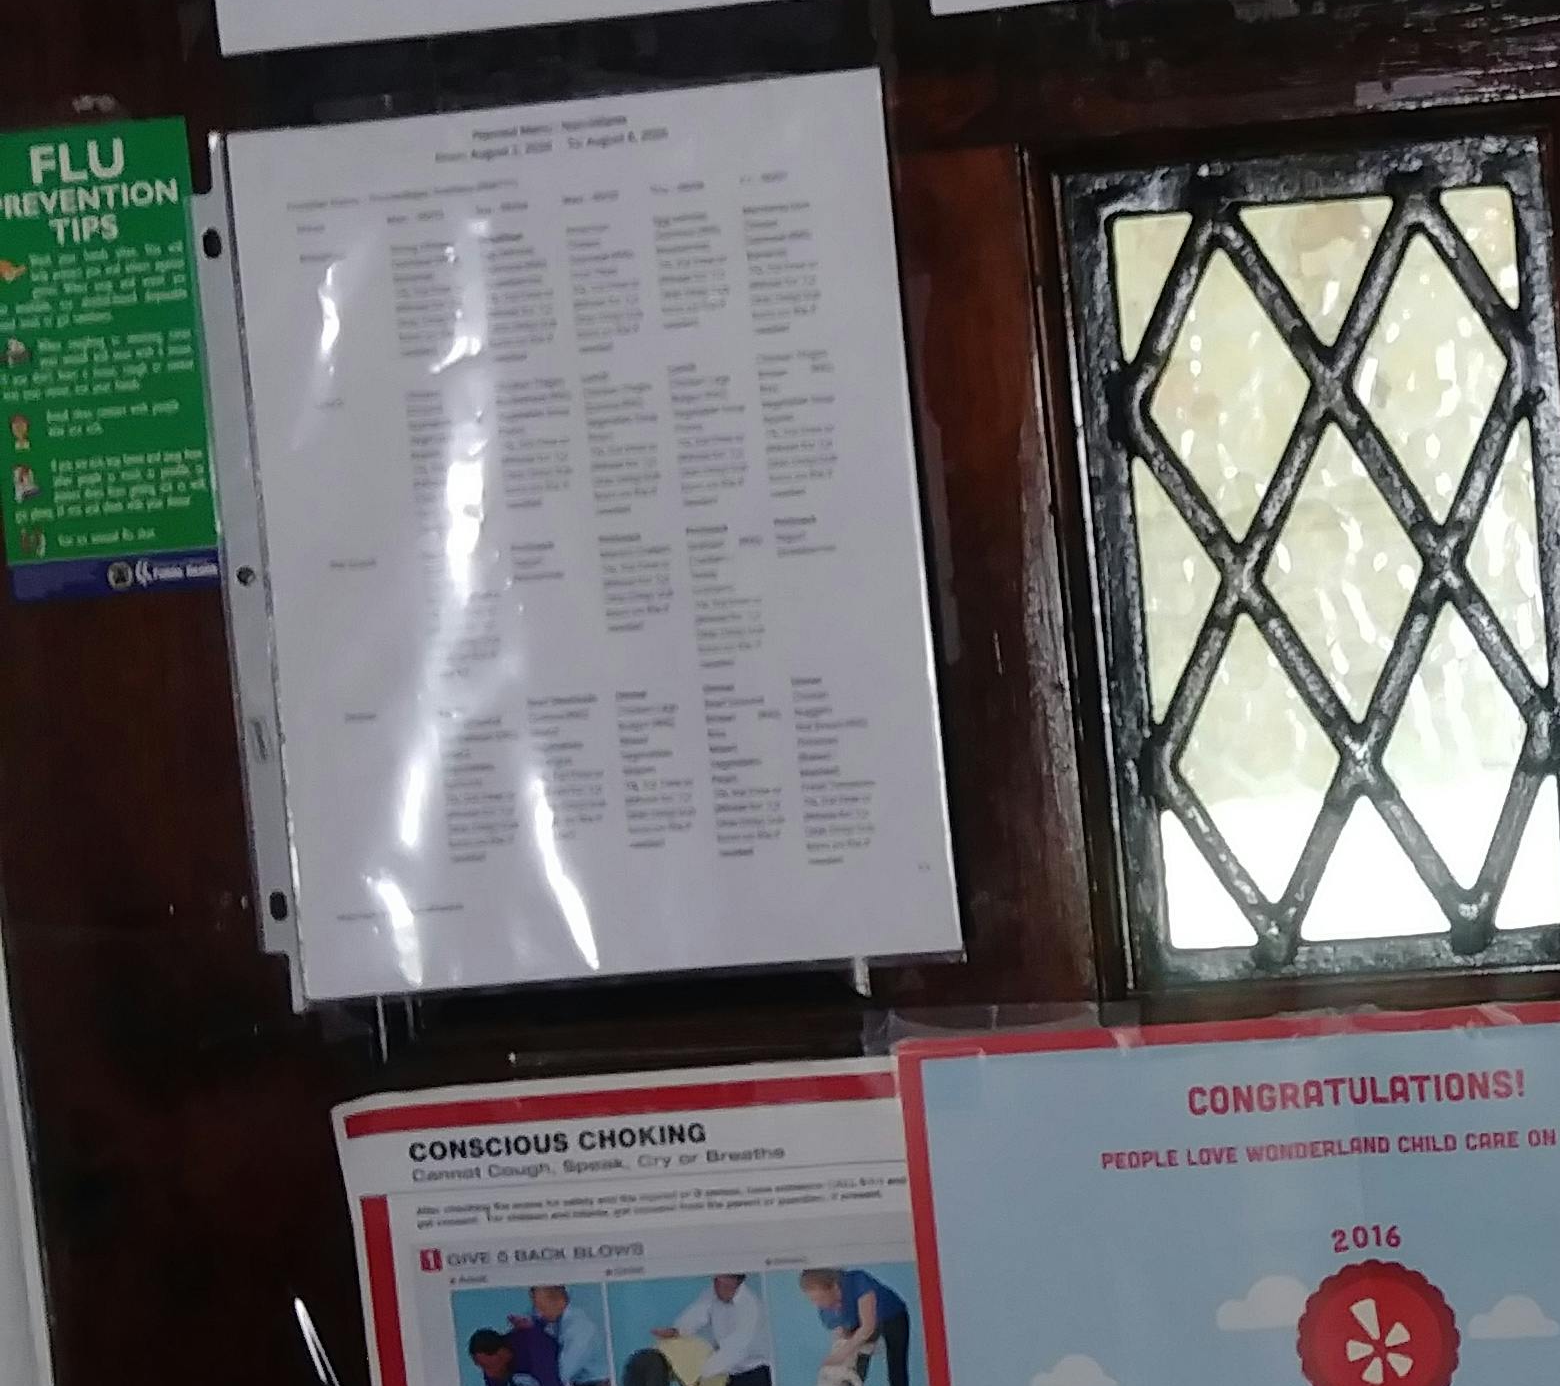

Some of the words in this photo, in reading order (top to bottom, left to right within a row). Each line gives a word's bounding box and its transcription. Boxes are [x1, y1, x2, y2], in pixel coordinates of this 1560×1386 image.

[30, 137, 126, 187] FLU
[0, 178, 179, 220] REVENTION
[49, 214, 120, 245] TIPS
[1187, 1069, 1527, 1117] CONGRATULATIONS!
[409, 1133, 569, 1163] CONSCIOUS
[579, 1122, 707, 1152] CHOKING
[1100, 1148, 1180, 1171] PEOPLE
[1187, 1145, 1238, 1167] LOVE
[1246, 1135, 1391, 1165] WONDERLAND
[1398, 1132, 1457, 1155] CHILD
[1466, 1129, 1520, 1152] CARE
[1527, 1127, 1557, 1148] ON
[412, 1166, 482, 1183] Cannot
[487, 1161, 556, 1181] Cough,
[637, 1152, 671, 1170] Cry
[679, 1153, 698, 1166] or
[706, 1146, 786, 1163] Breathe
[447, 1251, 490, 1268] GIVE
[515, 1246, 566, 1263] BACK
[574, 1242, 644, 1261] BLOWS
[1332, 1224, 1402, 1253] 2016
